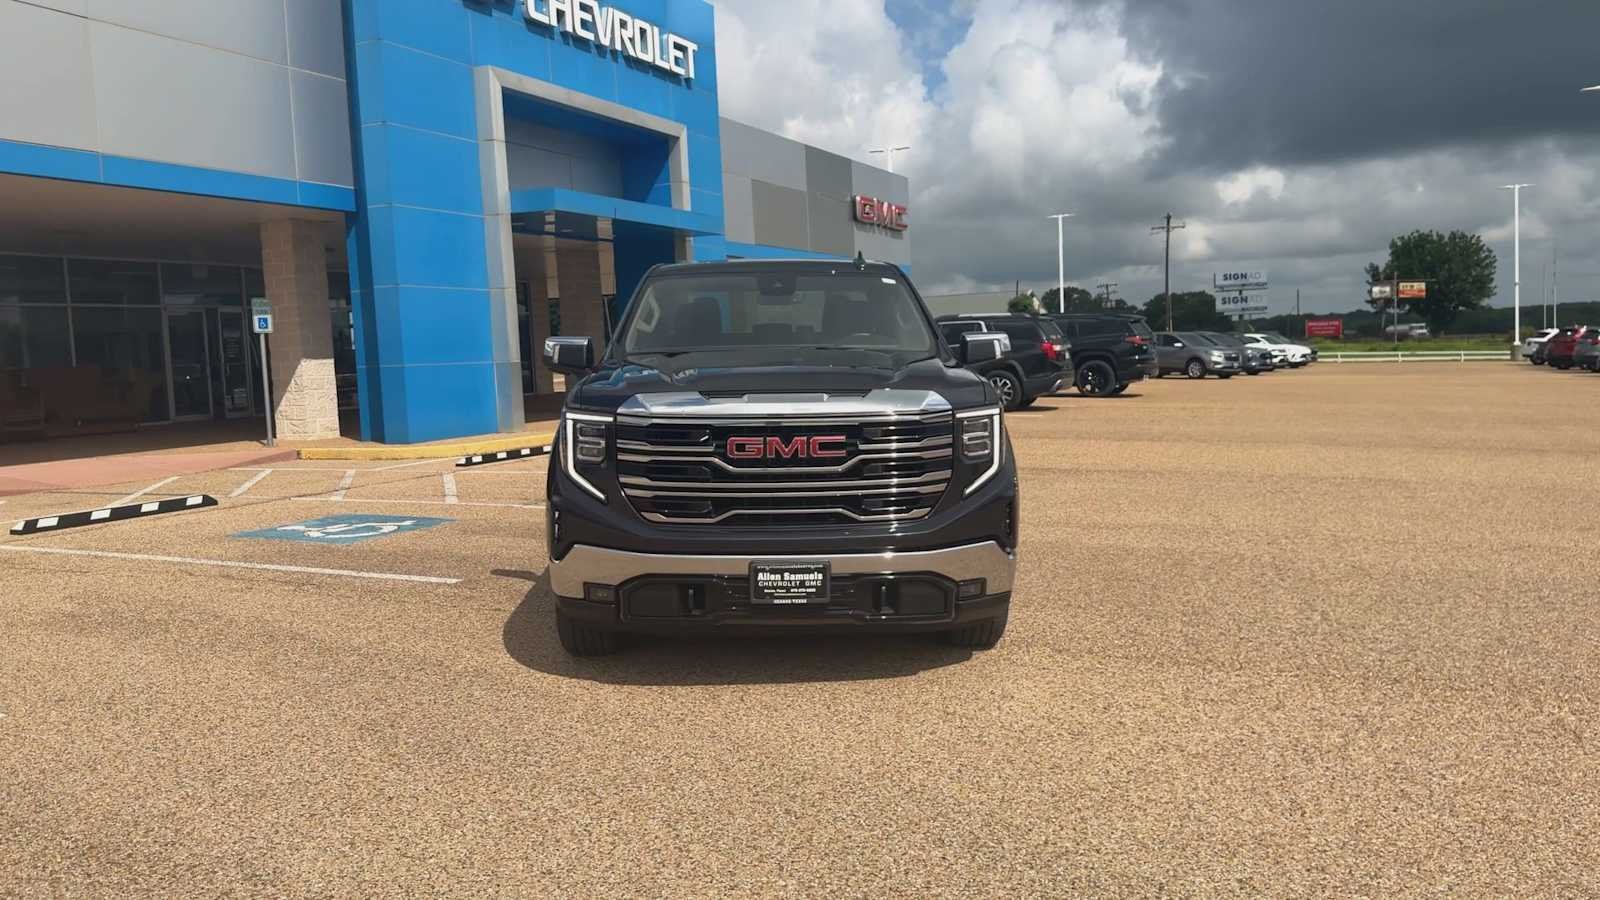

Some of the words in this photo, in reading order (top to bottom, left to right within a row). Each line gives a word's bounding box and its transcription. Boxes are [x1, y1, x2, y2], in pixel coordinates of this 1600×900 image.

[523, 0, 698, 79] CHEVROLET
[854, 194, 908, 231] GMC
[726, 435, 847, 459] GMC
[757, 572, 781, 580] Allen
[783, 572, 823, 580] Samuels
